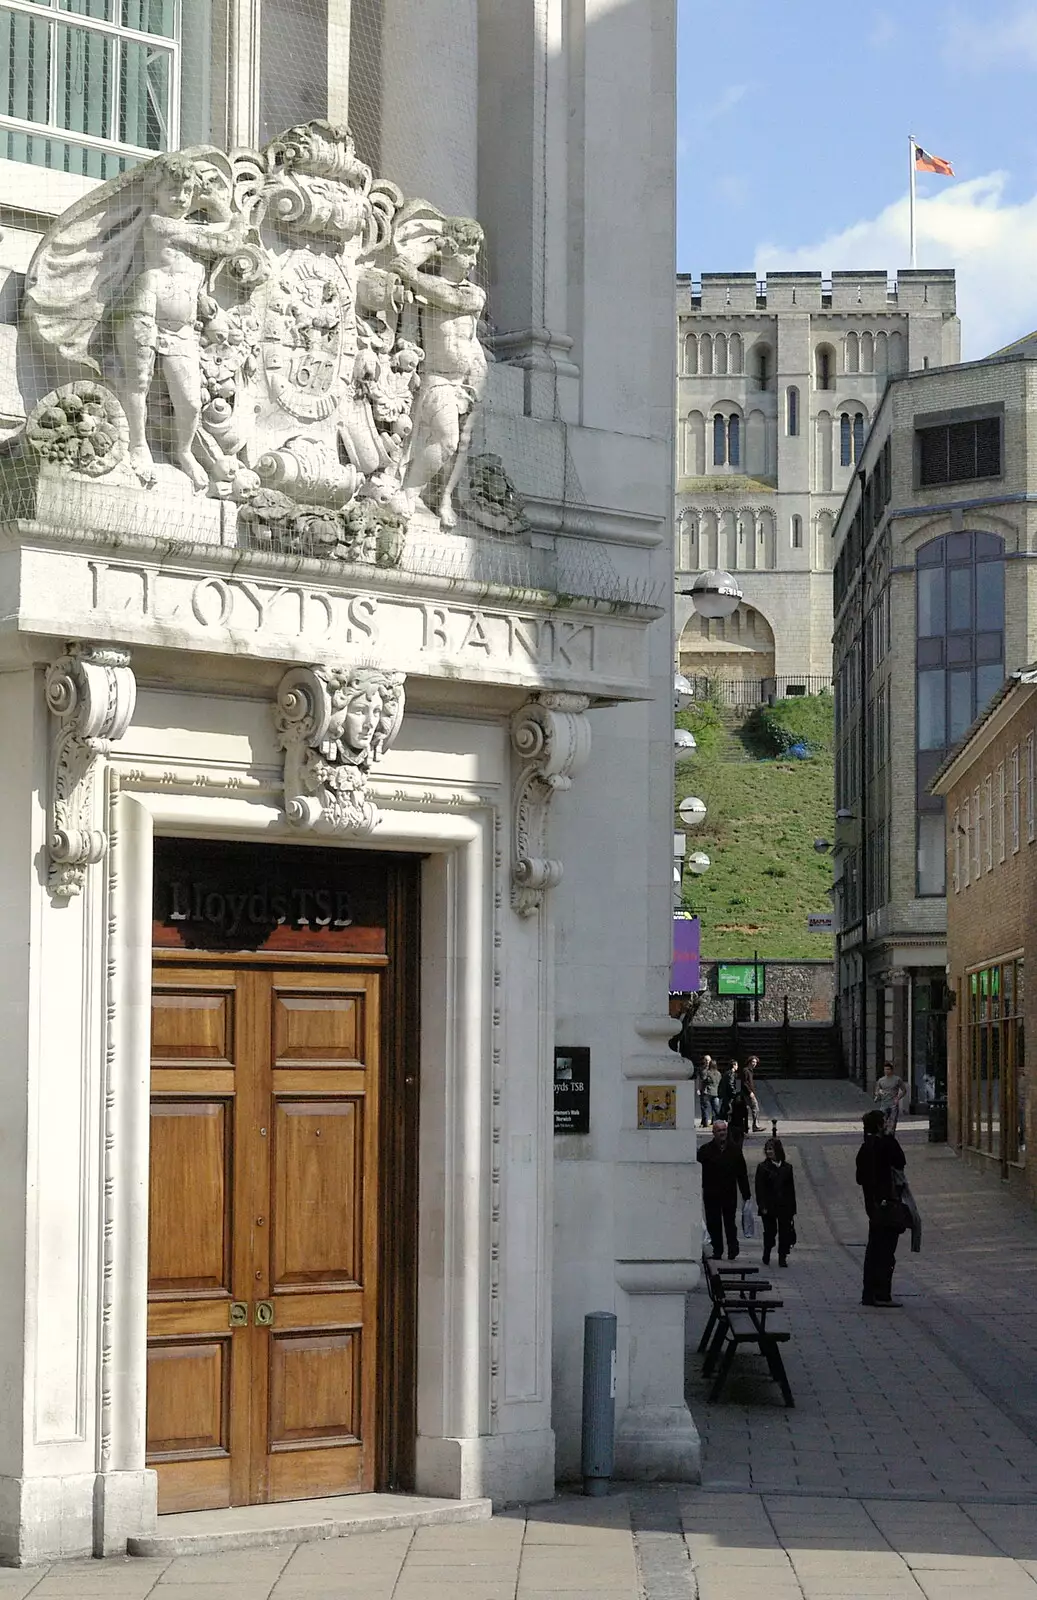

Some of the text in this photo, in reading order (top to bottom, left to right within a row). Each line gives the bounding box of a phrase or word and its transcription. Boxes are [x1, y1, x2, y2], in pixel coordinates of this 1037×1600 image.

[87, 561, 595, 671] LLOYDS BANK
[553, 1082, 584, 1094] oyds TSB
